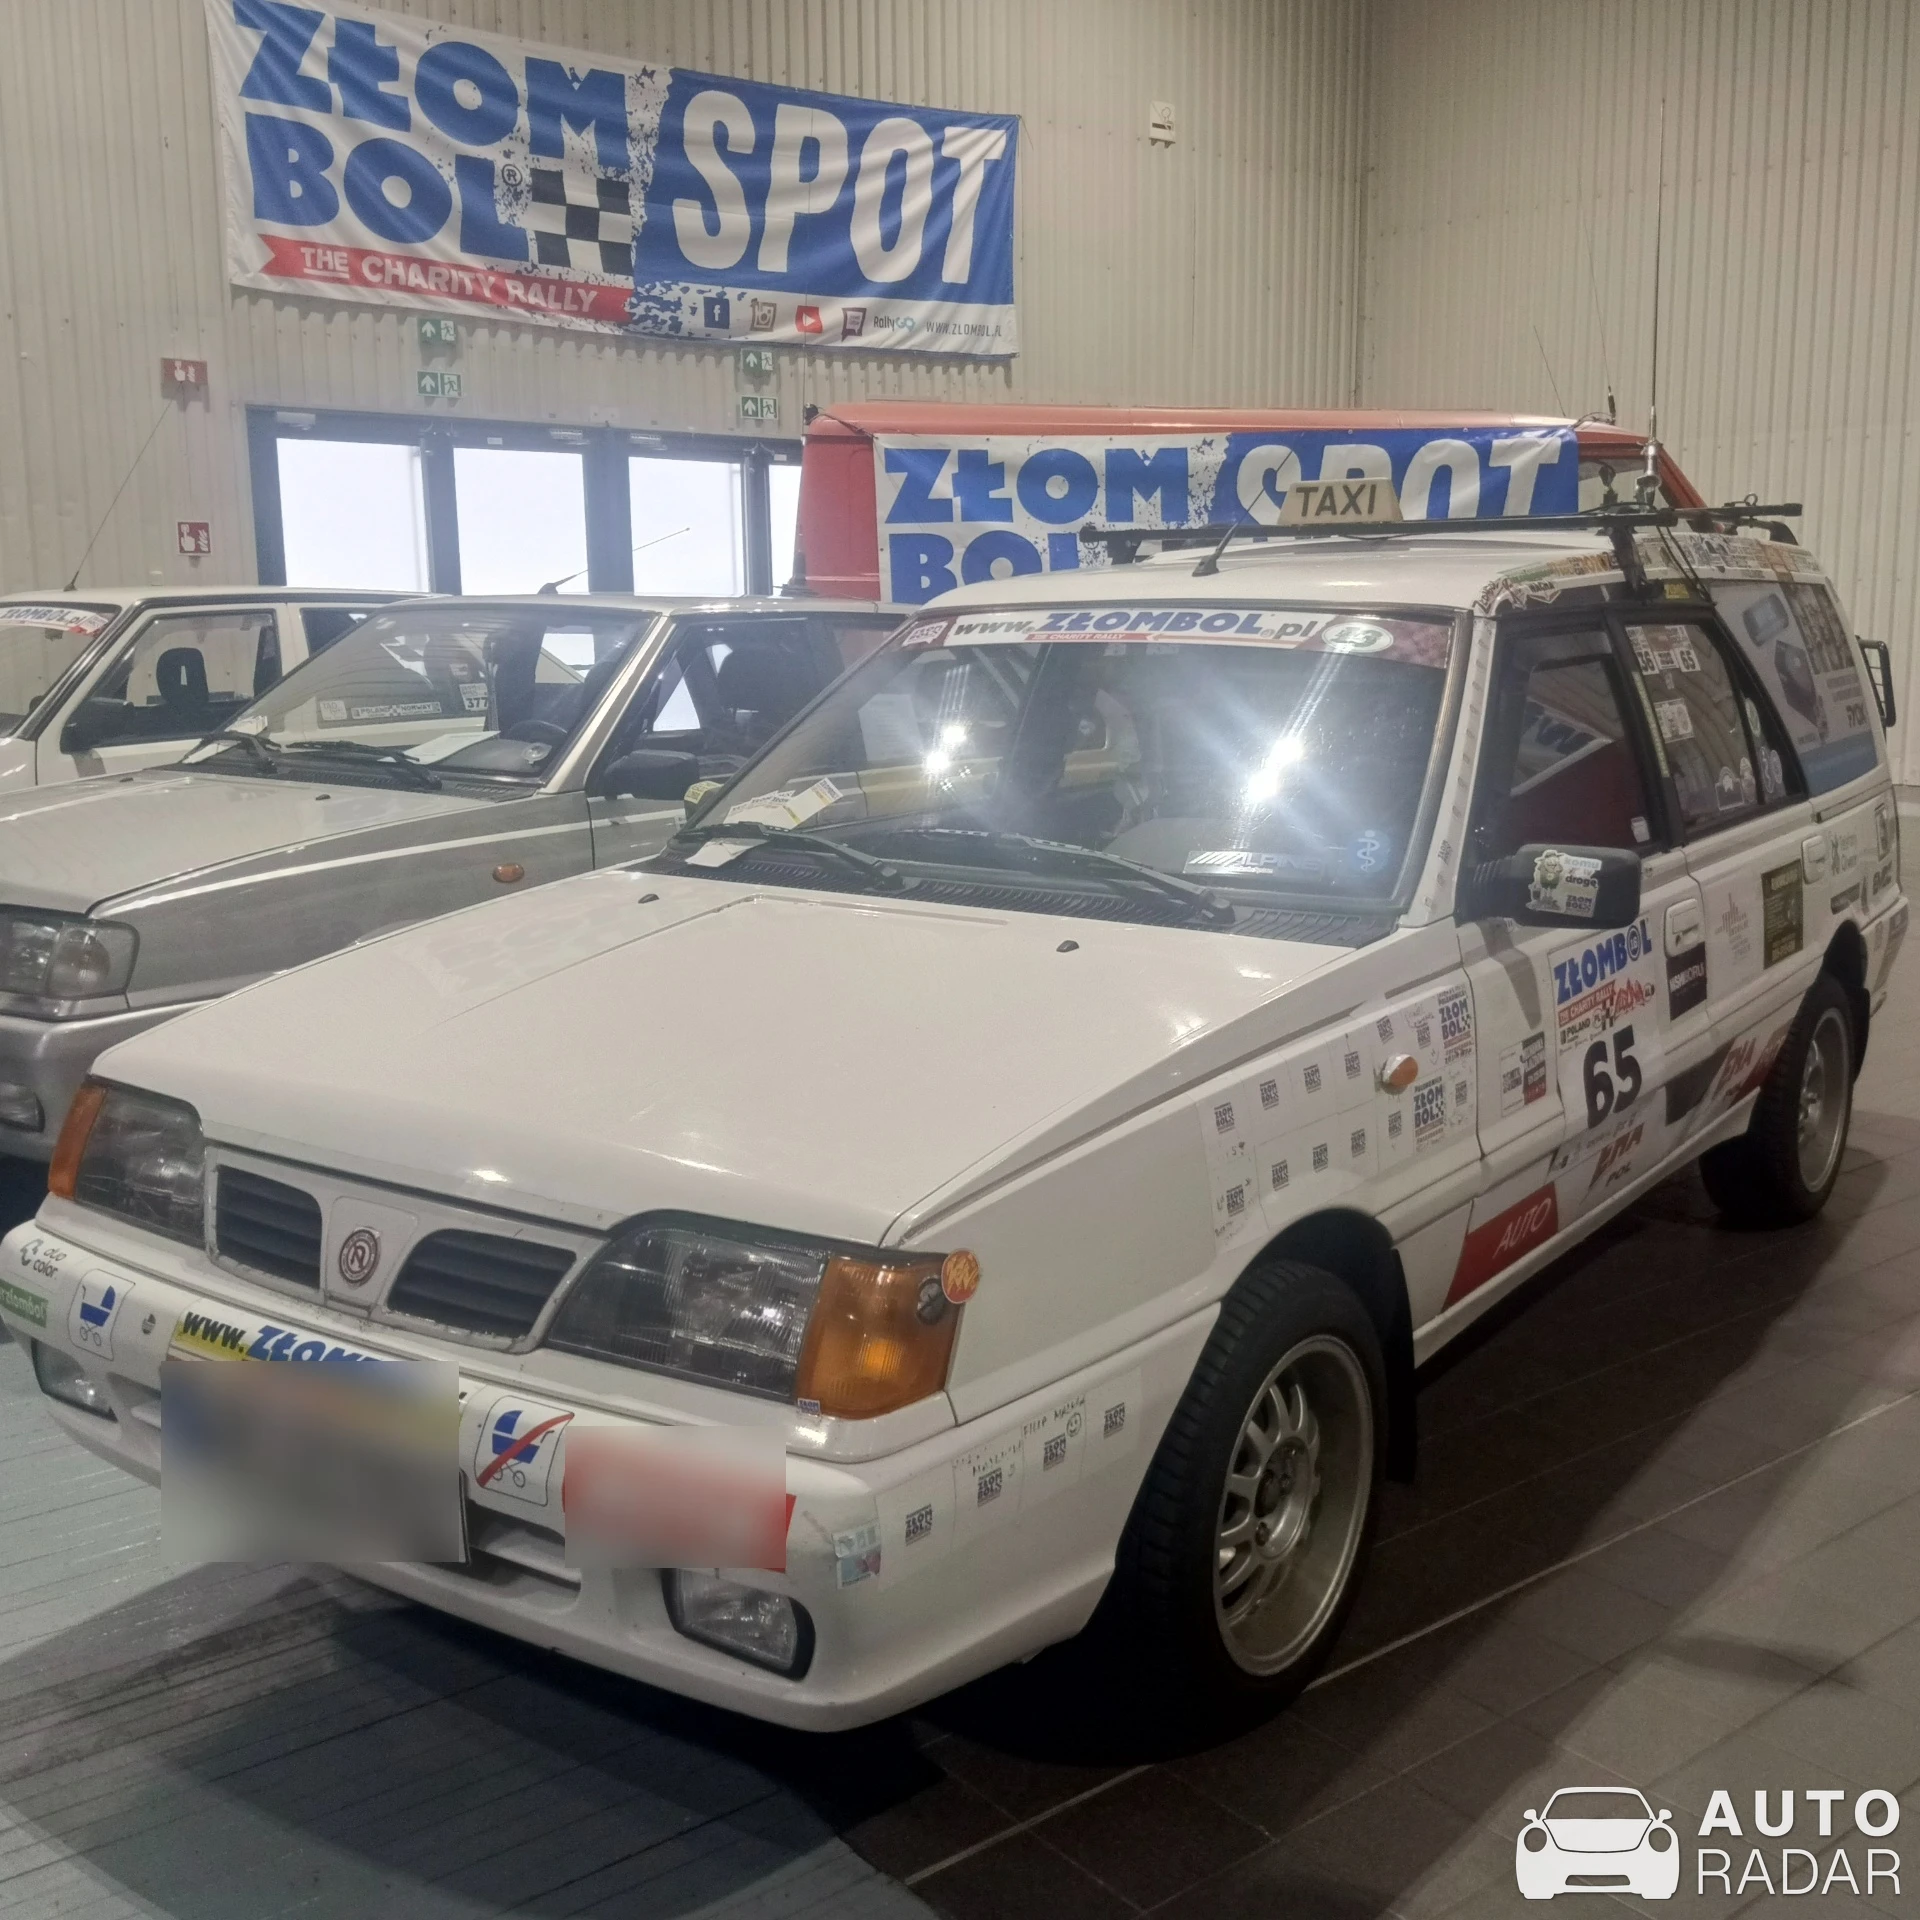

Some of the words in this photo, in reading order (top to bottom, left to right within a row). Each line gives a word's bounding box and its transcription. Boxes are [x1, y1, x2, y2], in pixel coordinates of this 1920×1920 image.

[233, 0, 626, 181] ZŁOM
[672, 90, 1007, 284] SPOT
[300, 246, 349, 277] THE
[361, 256, 496, 299] CHARITY
[505, 279, 598, 313] RALLY
[884, 447, 1189, 525] ZŁOM
[1296, 483, 1377, 518] TAXI
[1049, 633, 1091, 641] CHARITY
[1093, 633, 1124, 641] RALLY
[1583, 1024, 1642, 1129] 65
[1491, 1197, 1552, 1260] AUTO
